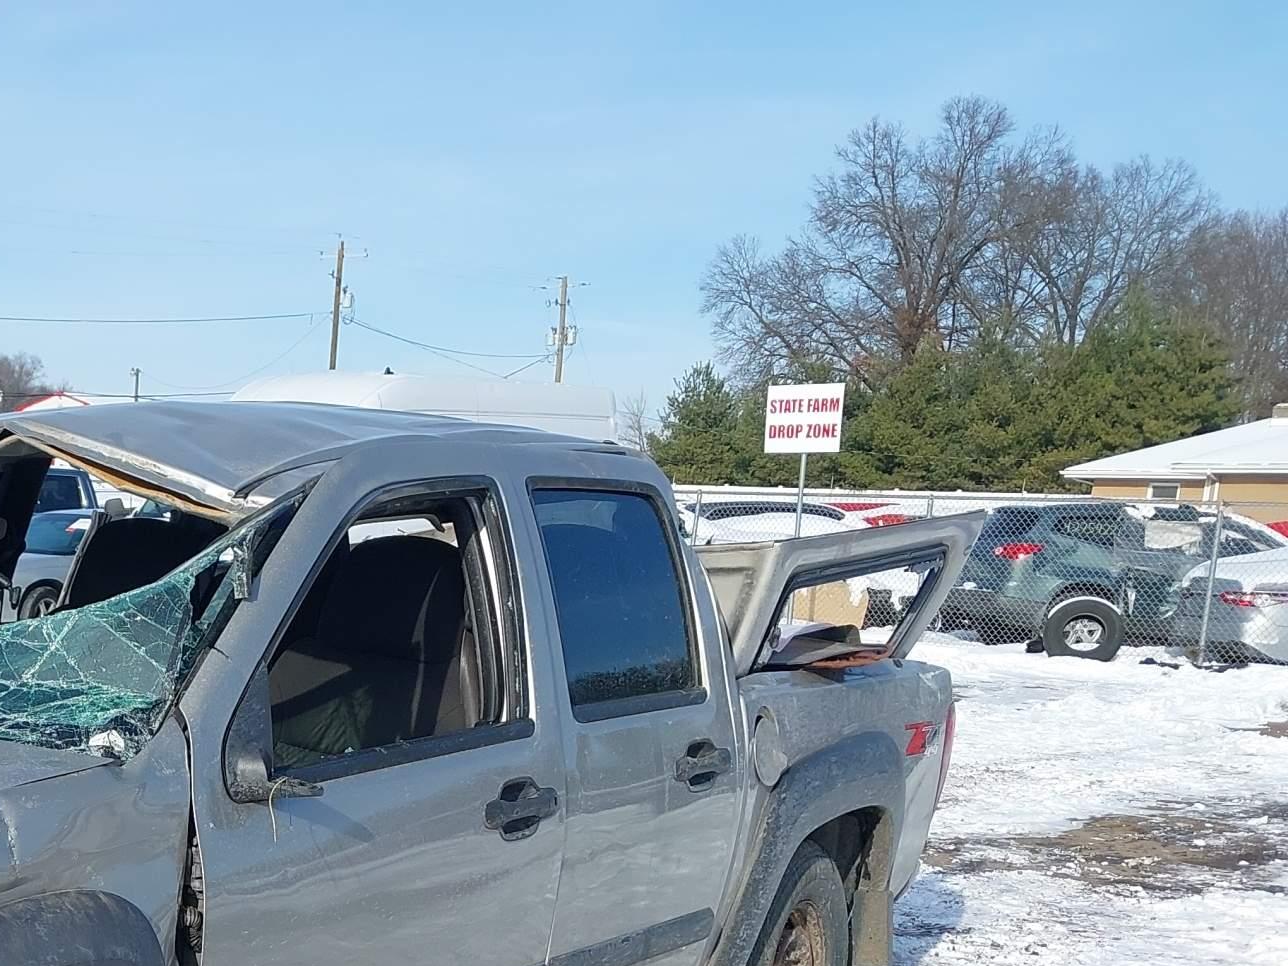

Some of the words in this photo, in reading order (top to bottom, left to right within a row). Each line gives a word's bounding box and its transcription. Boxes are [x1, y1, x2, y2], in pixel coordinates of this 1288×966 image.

[770, 399, 804, 414] STATE
[807, 398, 840, 413] FARM
[768, 424, 803, 439] DROP
[806, 424, 838, 438] ZONE
